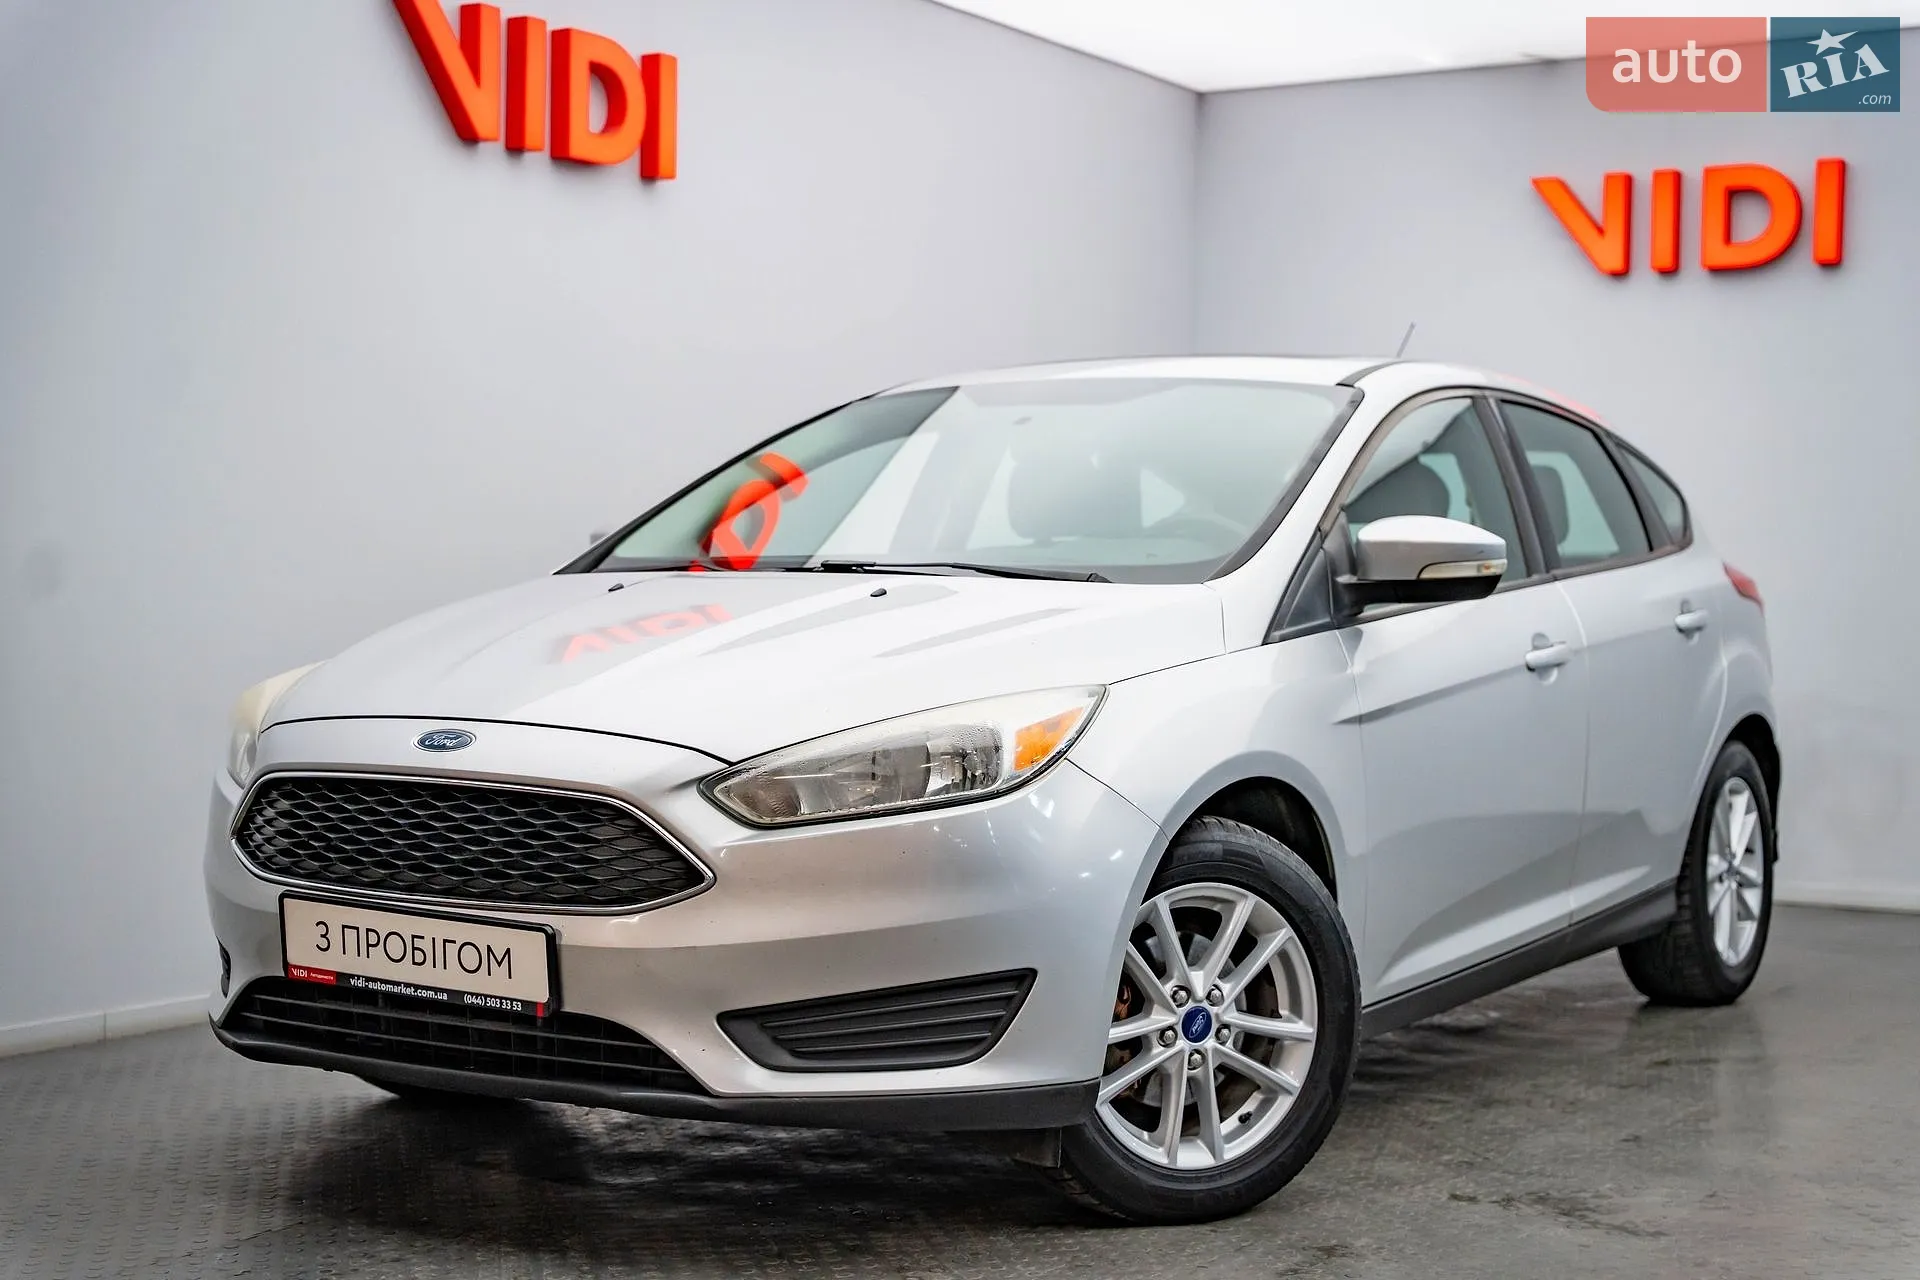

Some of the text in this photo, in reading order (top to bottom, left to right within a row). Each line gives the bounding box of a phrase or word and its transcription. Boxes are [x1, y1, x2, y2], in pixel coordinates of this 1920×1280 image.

[394, 0, 678, 180] VIDI
[1531, 156, 1846, 275] VIDI
[291, 967, 308, 978] VIDI
[315, 920, 512, 980] З ПРОБІГОМ
[349, 976, 522, 1011] vidi-automarket.com.ua (044) 503 33 53
